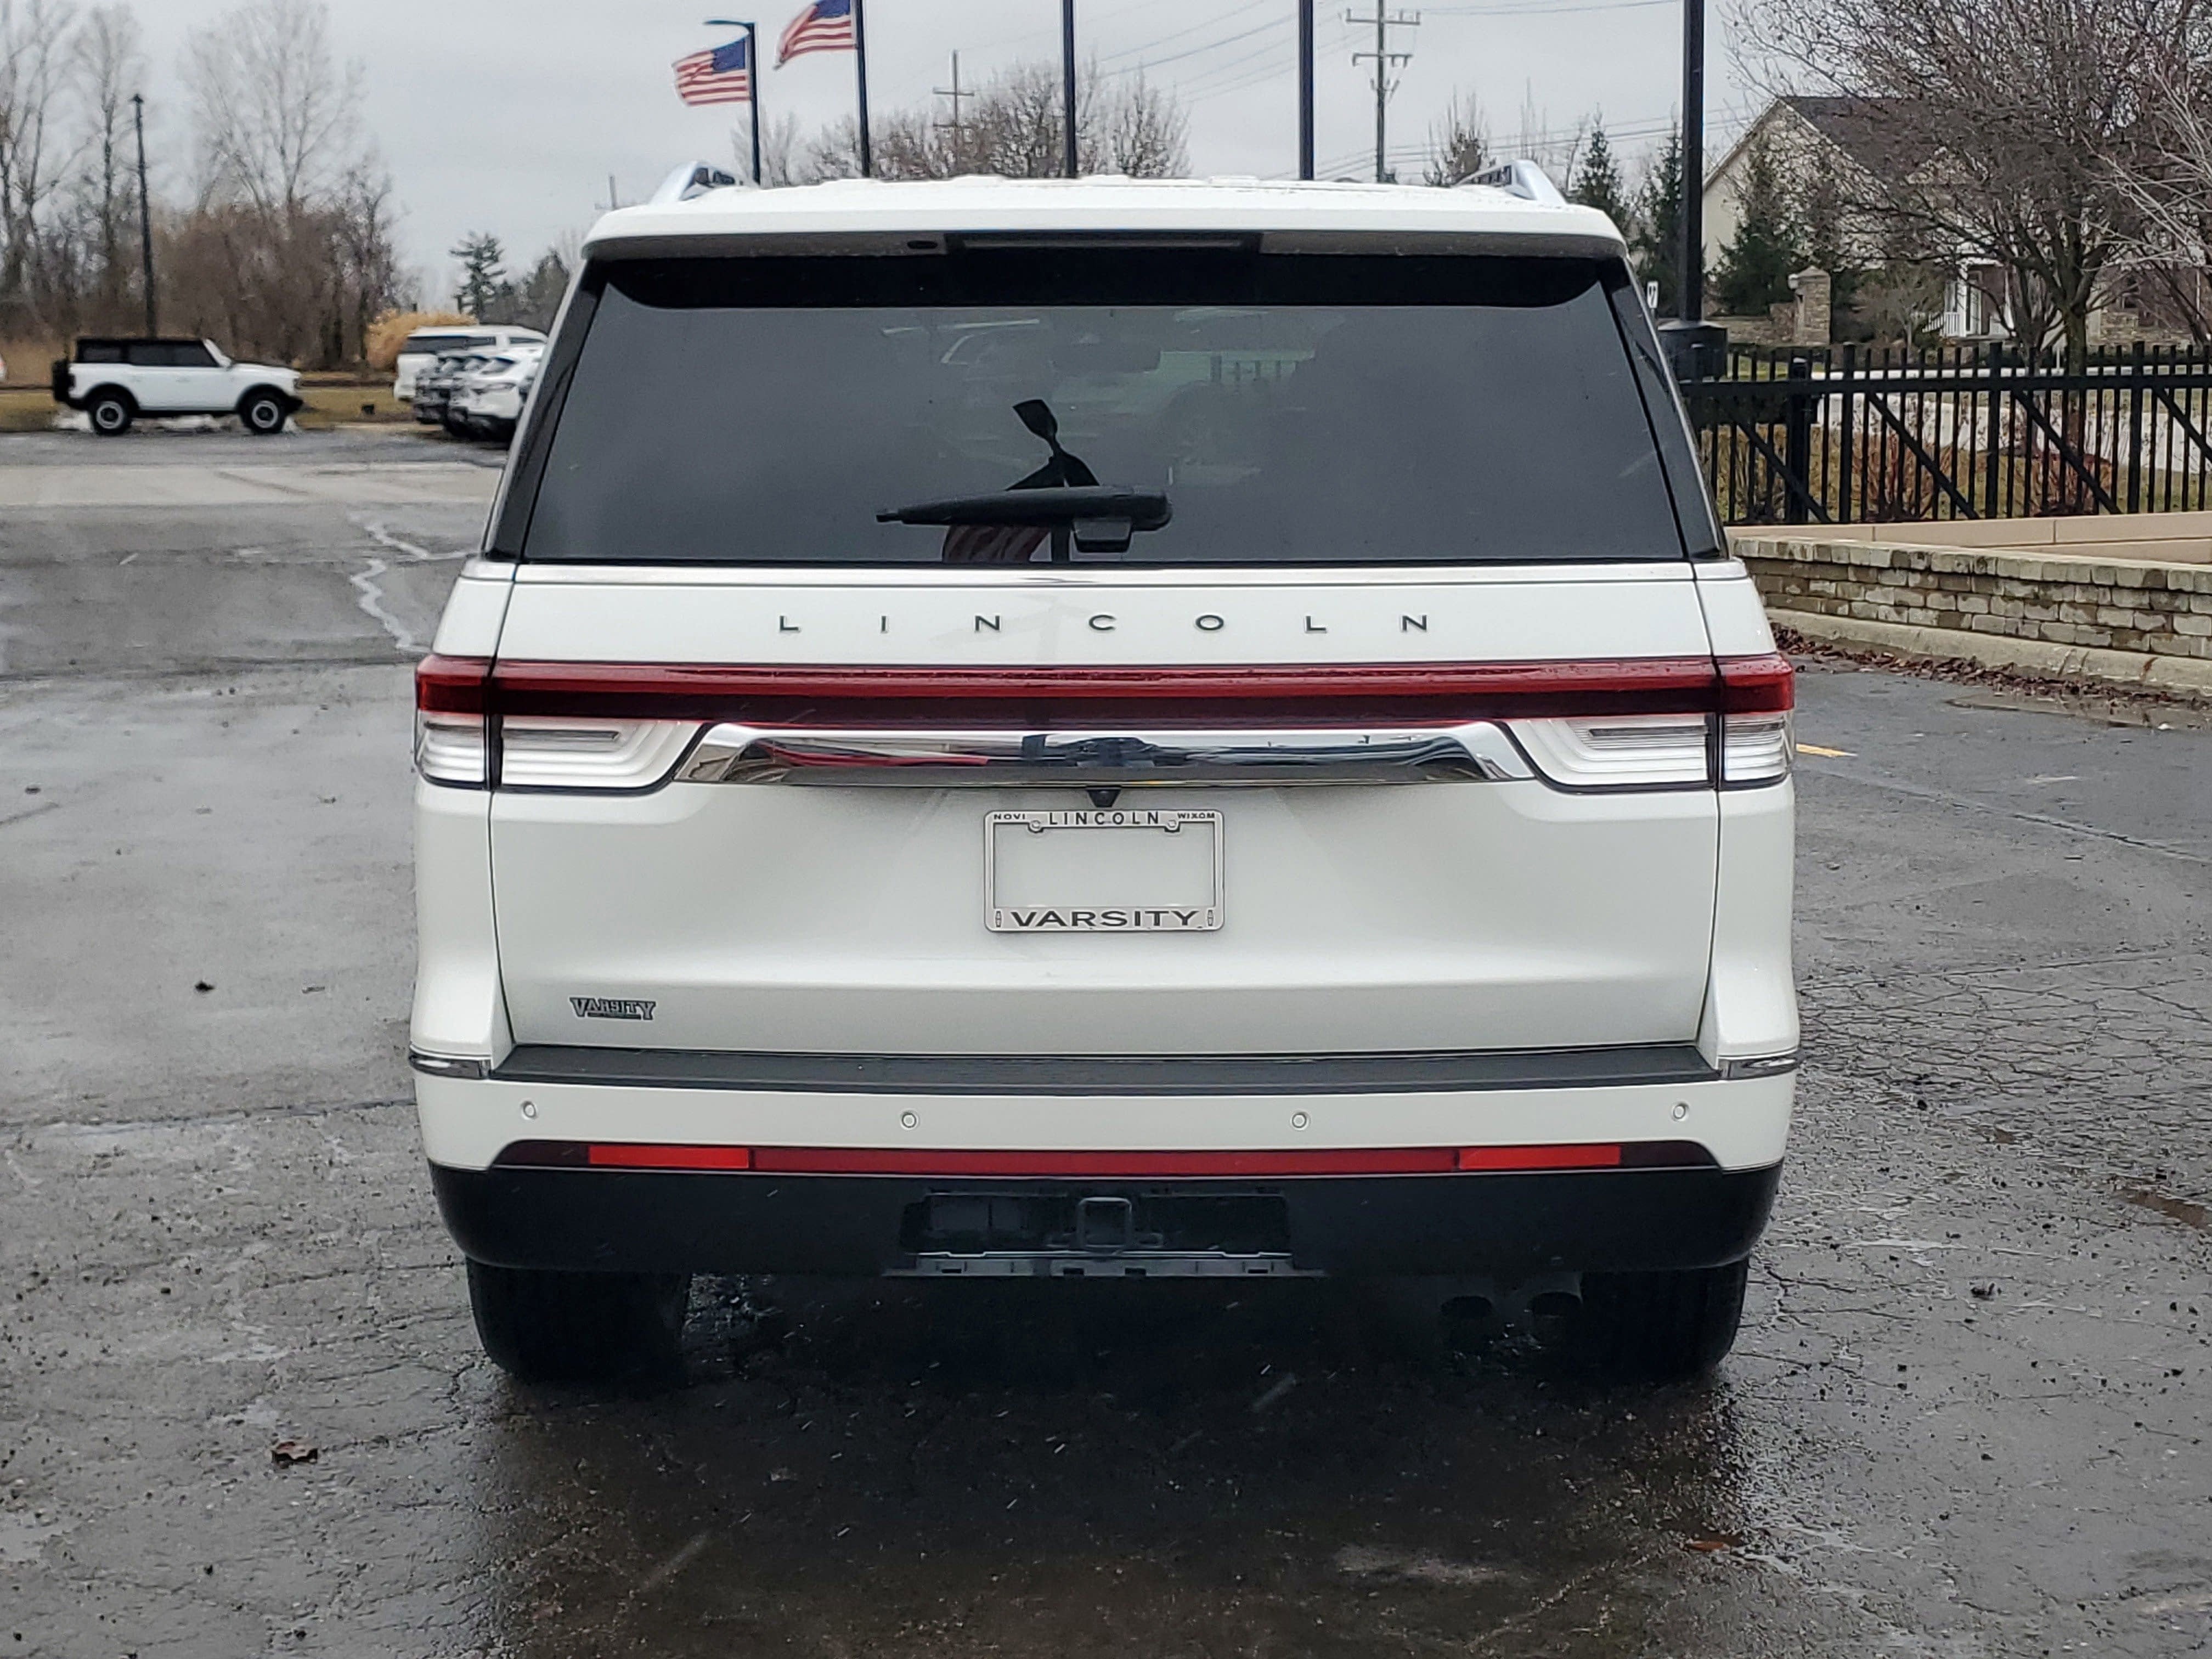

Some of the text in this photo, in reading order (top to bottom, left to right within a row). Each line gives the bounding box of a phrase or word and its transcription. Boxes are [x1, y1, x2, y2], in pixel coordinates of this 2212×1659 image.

[779, 614, 1429, 633] LINCOLN
[1048, 812, 1159, 825] LINCOLN
[1011, 911, 1200, 927] VARSITY
[569, 997, 656, 1020] VARSITY
